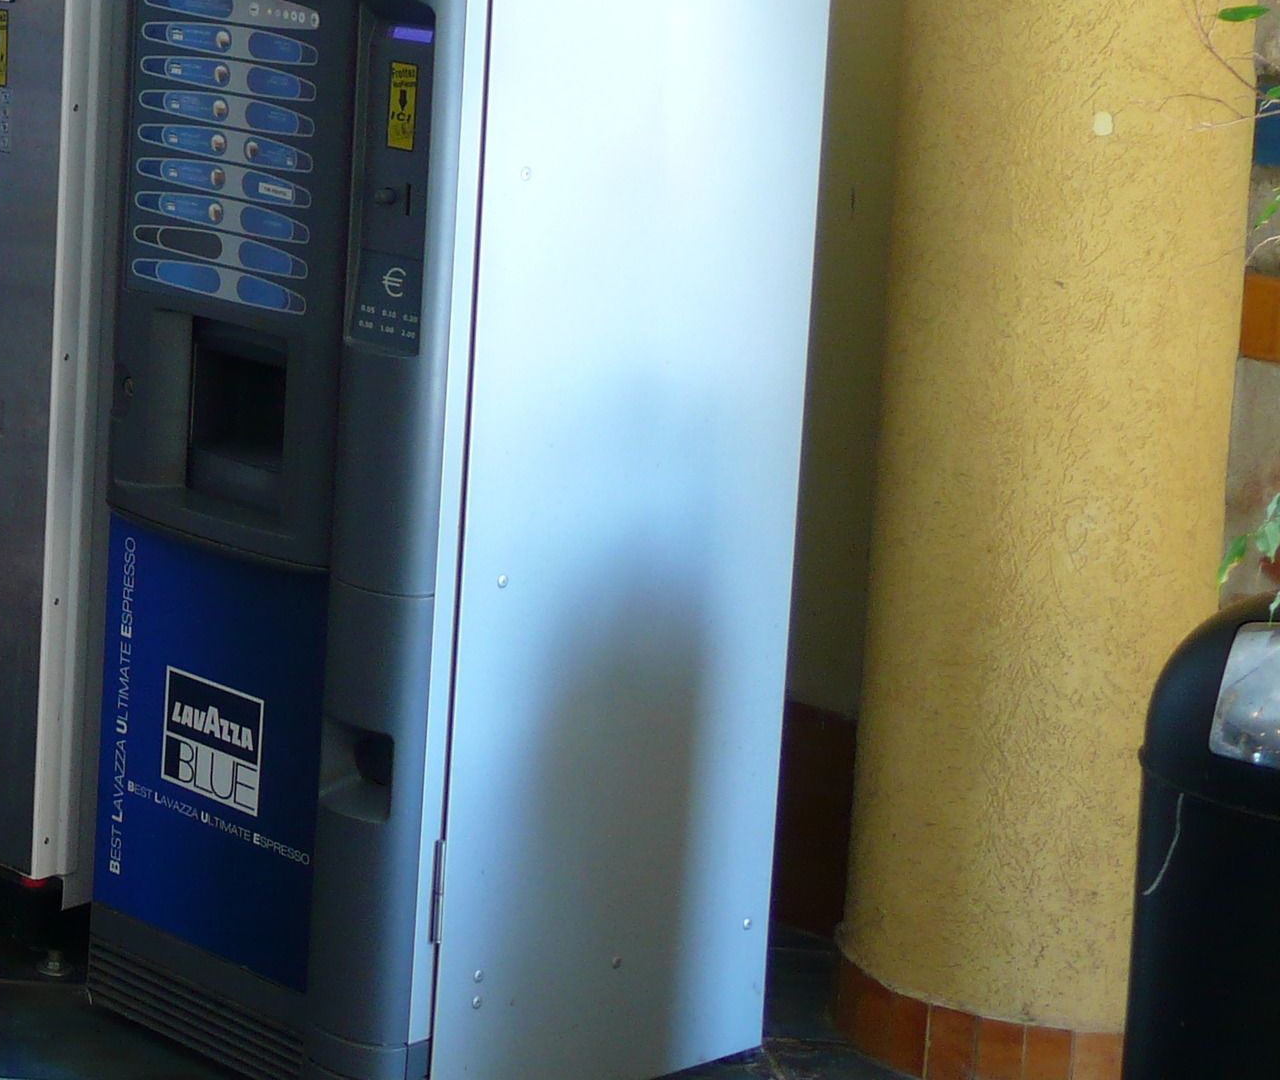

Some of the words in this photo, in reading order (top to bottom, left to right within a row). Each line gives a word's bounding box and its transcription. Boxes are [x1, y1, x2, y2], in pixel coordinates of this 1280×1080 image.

[120, 535, 138, 640] ESPRESSO
[114, 640, 134, 736] ULTIMATE
[171, 698, 255, 753] LAVAZZA
[110, 738, 130, 825] LAVAZZA
[174, 738, 259, 810] BLUE
[108, 824, 124, 876] BEST
[126, 779, 155, 801] BEST
[153, 791, 200, 821] LAVAZZA
[199, 808, 253, 842] ULTIMATE
[252, 831, 311, 867] ESPRESSO
